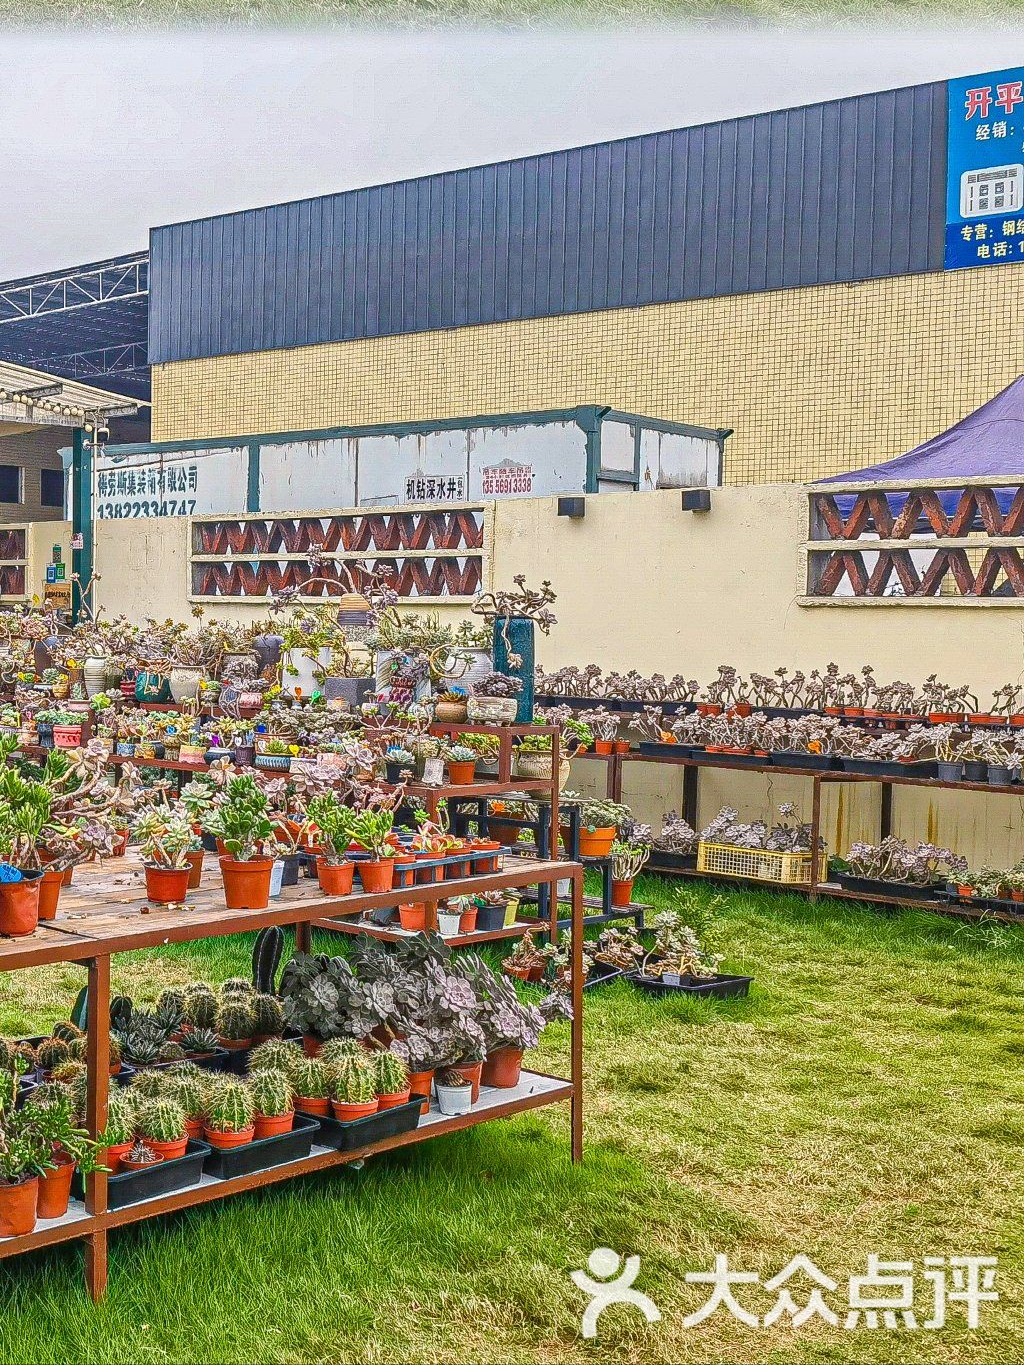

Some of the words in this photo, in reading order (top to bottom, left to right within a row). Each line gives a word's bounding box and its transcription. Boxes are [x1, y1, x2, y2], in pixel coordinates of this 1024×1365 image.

[965, 81, 1023, 120] 开平
[406, 477, 456, 500] 机钻深水井
